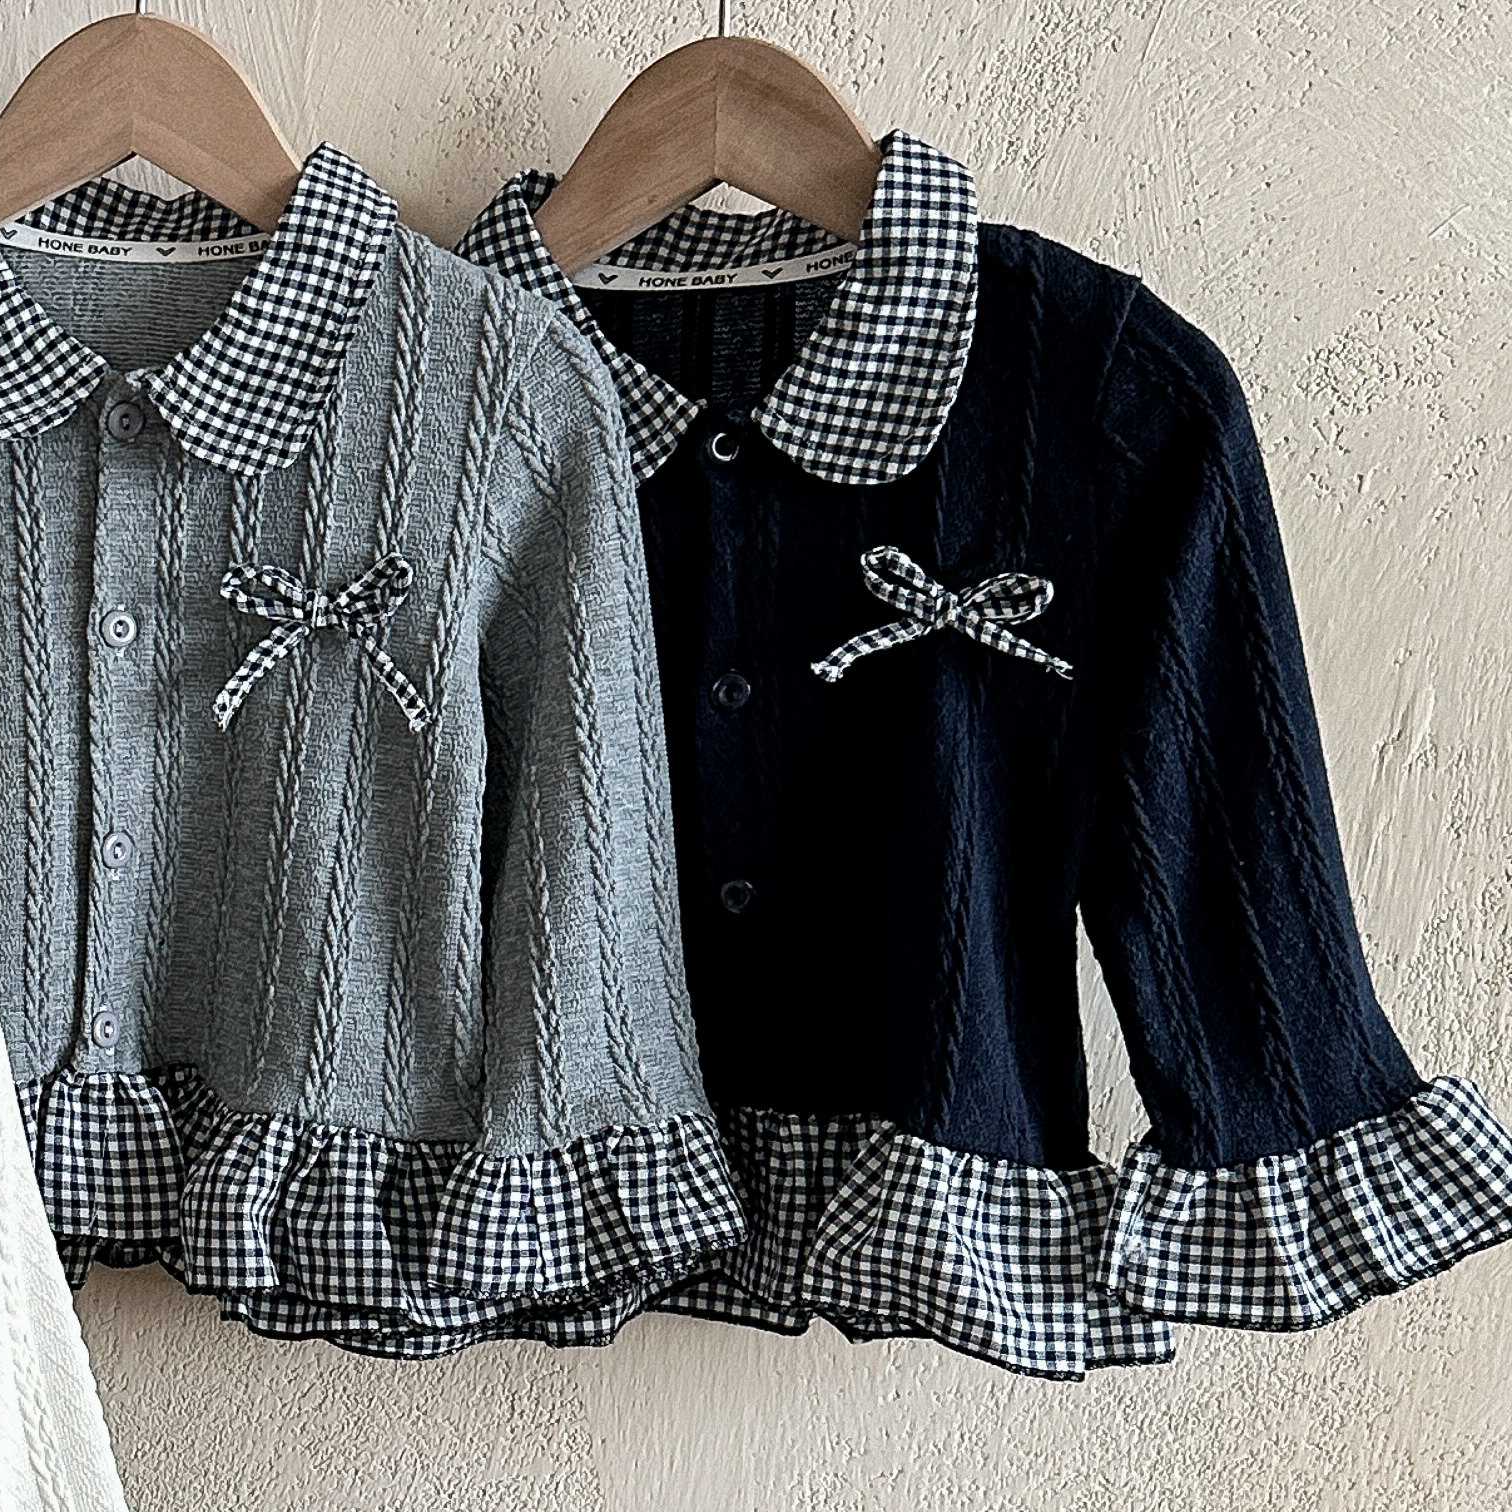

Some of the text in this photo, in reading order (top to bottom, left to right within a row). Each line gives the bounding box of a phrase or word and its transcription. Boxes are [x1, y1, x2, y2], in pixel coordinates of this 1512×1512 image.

[38, 237, 133, 257] HONE BABY
[197, 240, 269, 257] HONE BA
[639, 273, 738, 287] HONE BABY
